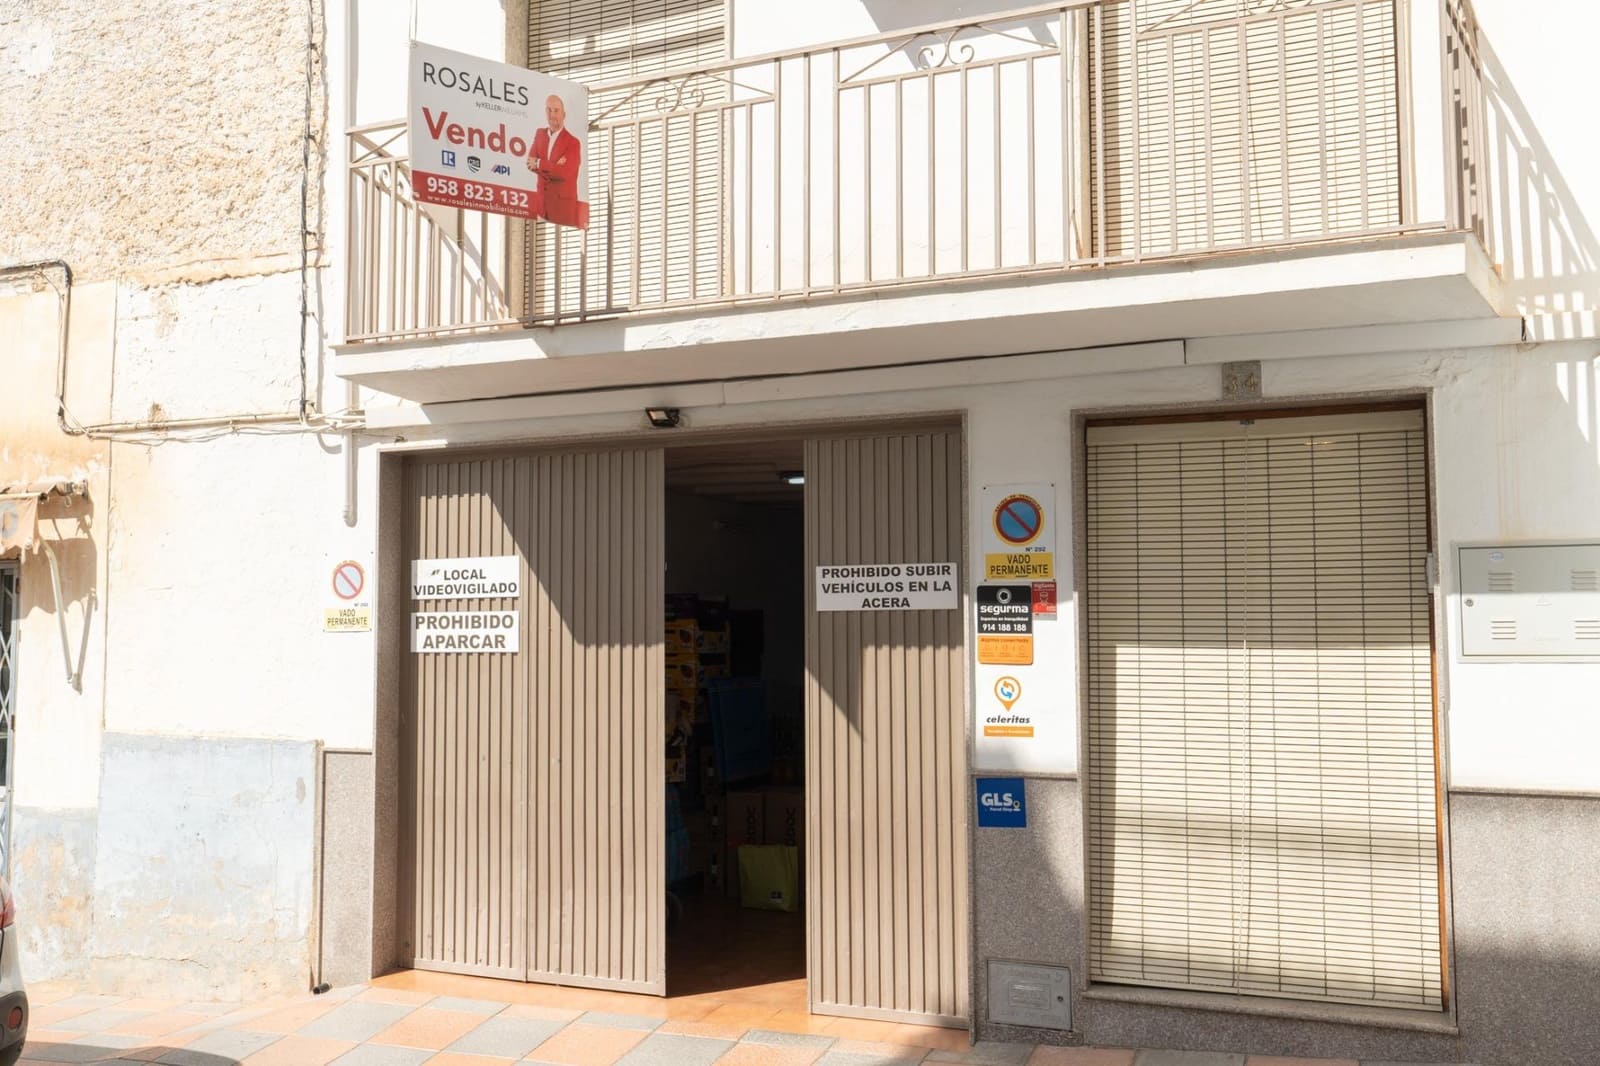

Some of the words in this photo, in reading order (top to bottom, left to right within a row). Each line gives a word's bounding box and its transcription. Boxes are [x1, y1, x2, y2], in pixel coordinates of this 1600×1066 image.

[423, 62, 529, 106] ROSALES
[421, 106, 527, 157] Vendo
[427, 176, 458, 196] 958
[463, 183, 494, 202] 823
[500, 189, 529, 208] 132
[1007, 554, 1031, 564] VADO
[443, 568, 487, 581] LOCAL
[822, 566, 901, 578] PROHIBIDO
[905, 565, 951, 576] SUBIR
[990, 564, 1049, 575] PERMANENTE
[414, 582, 518, 596] VIDEOVIGILADO
[822, 580, 904, 594] VEHÍCULOS
[908, 581, 928, 592] EN
[933, 581, 952, 592] LA
[861, 597, 911, 609] ACERA
[338, 608, 356, 617] VADO
[980, 605, 1029, 616] segurma
[327, 617, 368, 626] PERMANENTE
[415, 614, 514, 630] PROHIBIDO
[982, 623, 996, 632] 914
[998, 623, 1011, 632] 188
[1013, 623, 1027, 632] 188
[422, 634, 506, 649] APARCAR
[986, 715, 1030, 724] celeritas
[981, 793, 1013, 807] GLS
